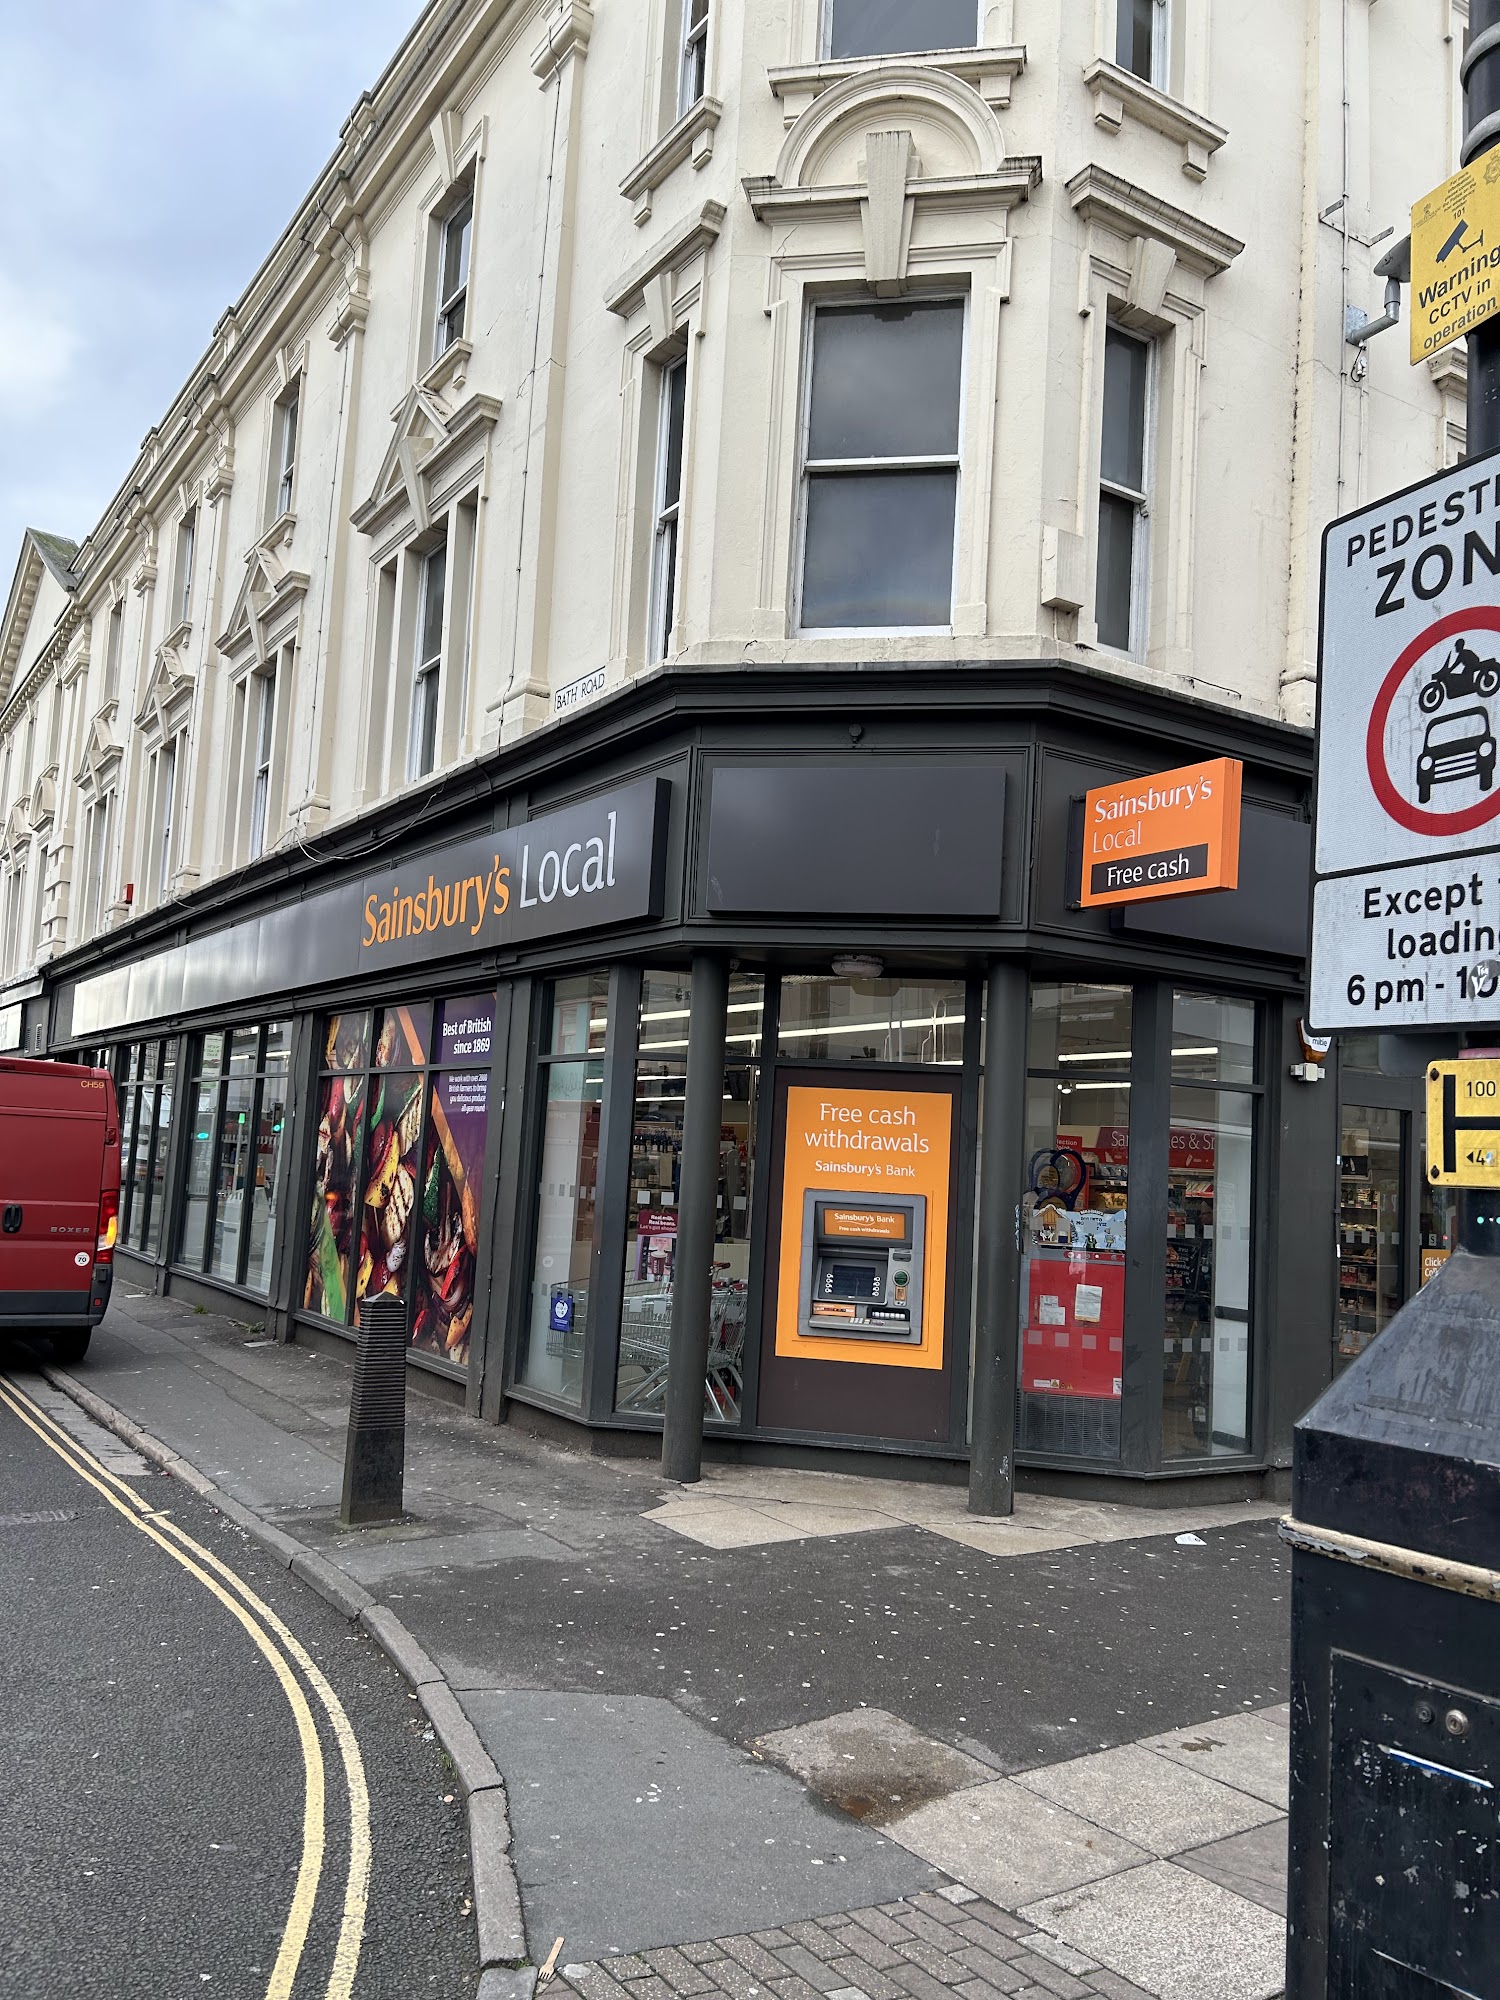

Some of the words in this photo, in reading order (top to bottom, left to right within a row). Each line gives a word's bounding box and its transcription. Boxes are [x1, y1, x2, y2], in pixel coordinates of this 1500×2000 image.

[1453, 206, 1466, 220] 101
[1418, 245, 1500, 309] Warning
[1429, 287, 1472, 325] CCTV
[1477, 278, 1491, 297] in
[1423, 295, 1496, 350] operation
[1347, 474, 1500, 568] PEDEST
[556, 686, 578, 710] BATH
[581, 674, 605, 698] ROAD
[1094, 776, 1212, 822] Sainsbury's
[1093, 820, 1142, 853] Local
[362, 854, 510, 948] Sainsbury's
[520, 811, 617, 908] Local
[1107, 866, 1143, 887] Free
[1148, 853, 1190, 880] cash
[1364, 872, 1482, 919] Except
[1388, 919, 1500, 960] loadin
[1348, 974, 1365, 1006] 6
[1375, 978, 1424, 1010] pm
[443, 1022, 458, 1036] Best
[459, 1020, 467, 1034] of
[467, 1017, 492, 1033] British
[454, 1040, 472, 1054] since
[473, 1038, 490, 1052] 1869
[81, 1080, 104, 1088] CH59
[1467, 1081, 1496, 1096] 100
[820, 1103, 862, 1122] Free
[868, 1106, 916, 1126] cash
[804, 1129, 929, 1153] withdrawals
[815, 1160, 882, 1176] Sainsbury's
[886, 1165, 915, 1176] Bank
[834, 1213, 874, 1222] Sainsbury's
[1425, 1258, 1441, 1266] Click
